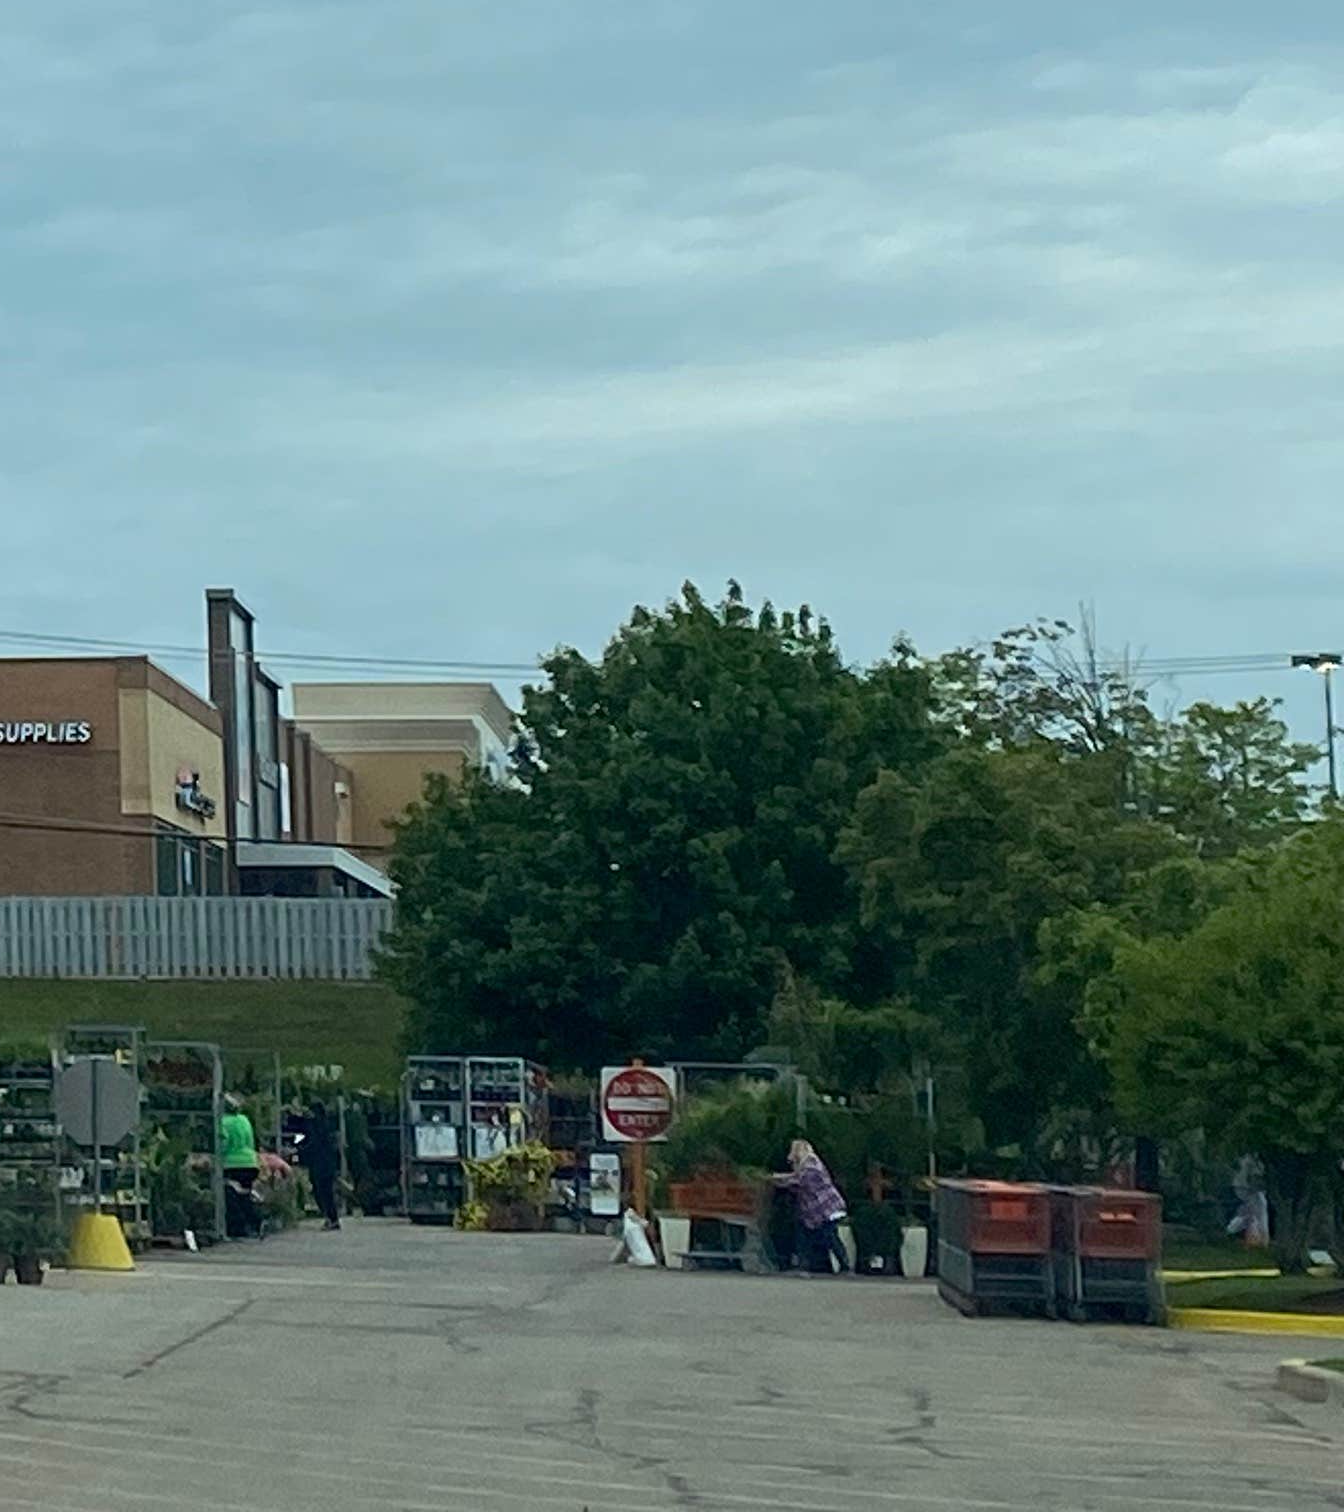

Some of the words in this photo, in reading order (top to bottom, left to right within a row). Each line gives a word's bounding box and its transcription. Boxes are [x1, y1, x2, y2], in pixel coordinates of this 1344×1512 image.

[613, 1080, 632, 1096] DO
[637, 1080, 666, 1096] NOT
[618, 1113, 665, 1129] ENTER
